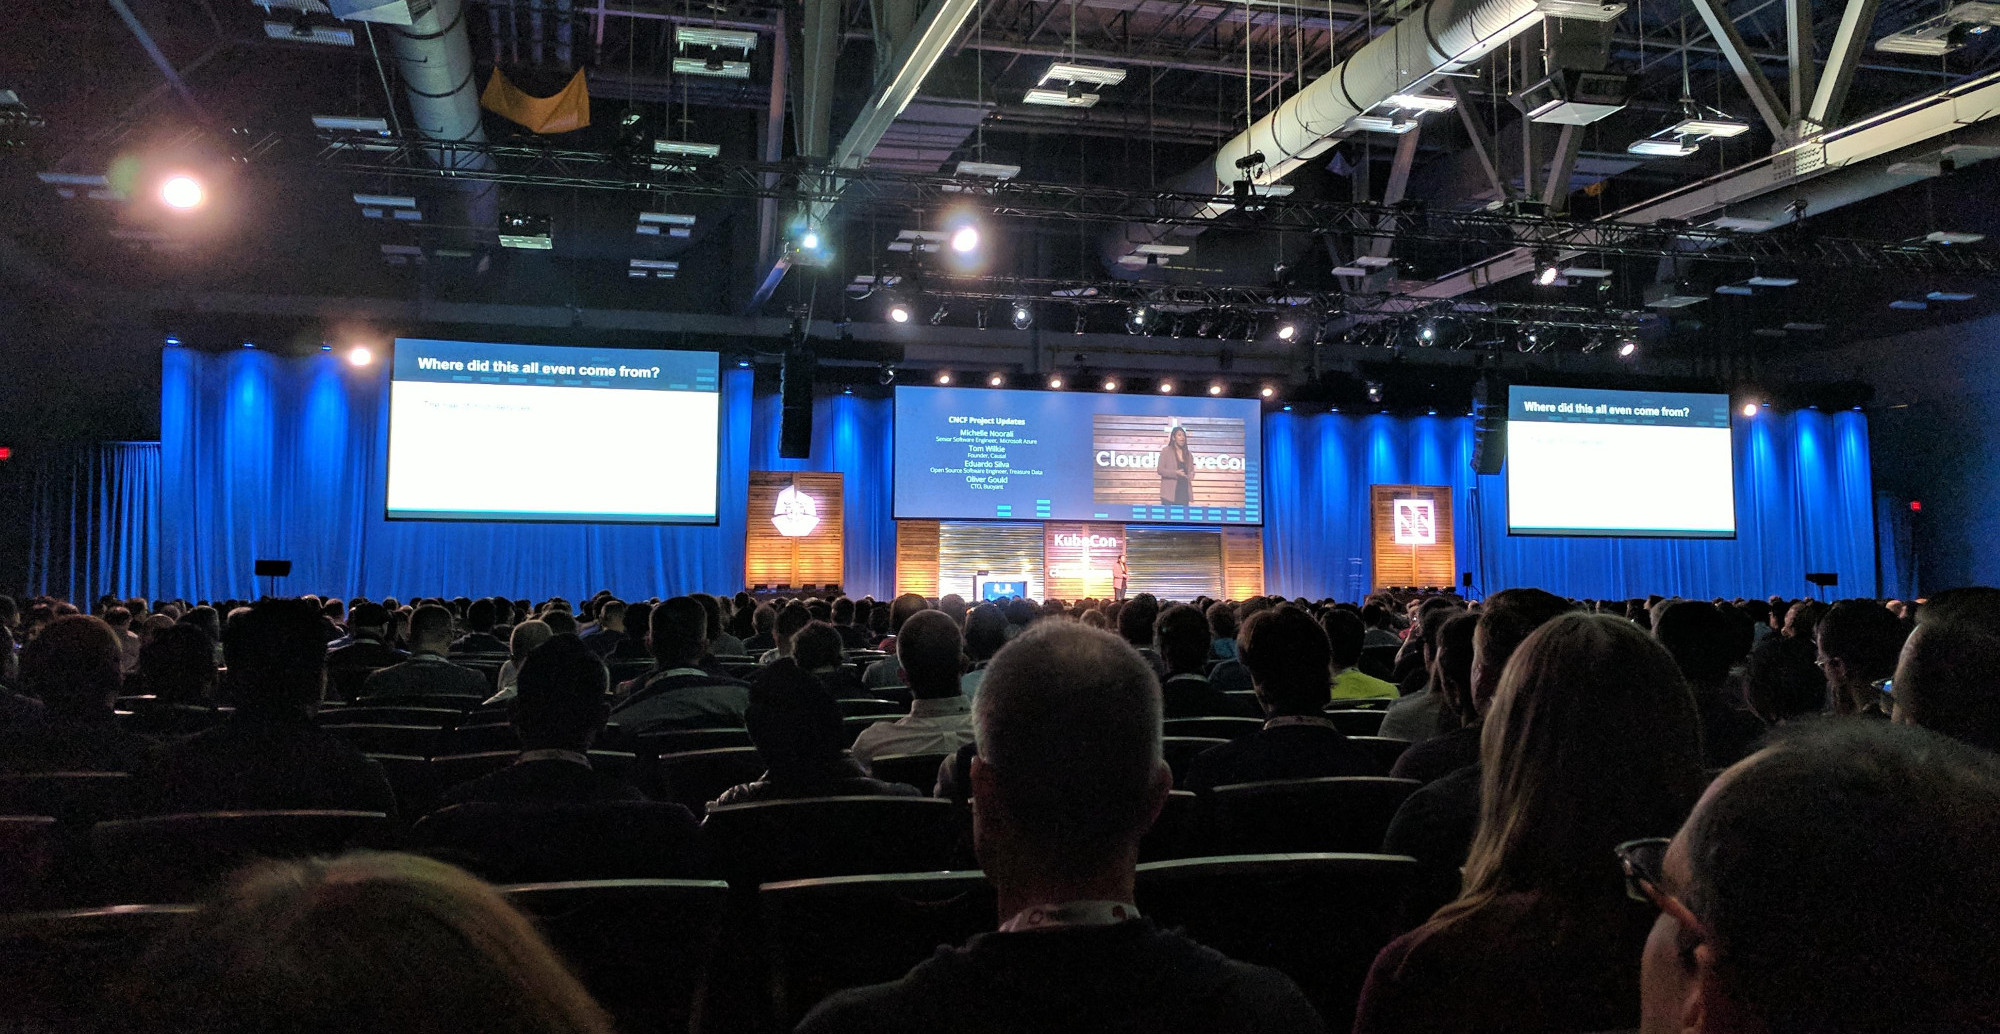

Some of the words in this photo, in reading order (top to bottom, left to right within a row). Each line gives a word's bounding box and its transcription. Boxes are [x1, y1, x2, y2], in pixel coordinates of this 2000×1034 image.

[418, 357, 464, 371] Where
[467, 359, 489, 372] did
[492, 361, 519, 373] this
[522, 362, 539, 374] all
[542, 365, 575, 375] even
[579, 366, 616, 376] come
[619, 365, 660, 379] from?
[1524, 401, 1556, 412] Where
[1558, 402, 1573, 413] did
[1575, 403, 1594, 414] this
[1596, 404, 1607, 414] all
[1609, 406, 1632, 415] even
[1634, 407, 1660, 416] come
[1662, 405, 1690, 417] from?
[948, 416, 968, 424] CNCF
[969, 417, 995, 426] Project
[996, 418, 1025, 426] Updates
[960, 429, 988, 437] Michelle
[985, 445, 1006, 453] Wilkie
[964, 460, 993, 468] Eduardo
[987, 476, 1008, 484] Gould
[1054, 533, 1117, 547] KubeCon
